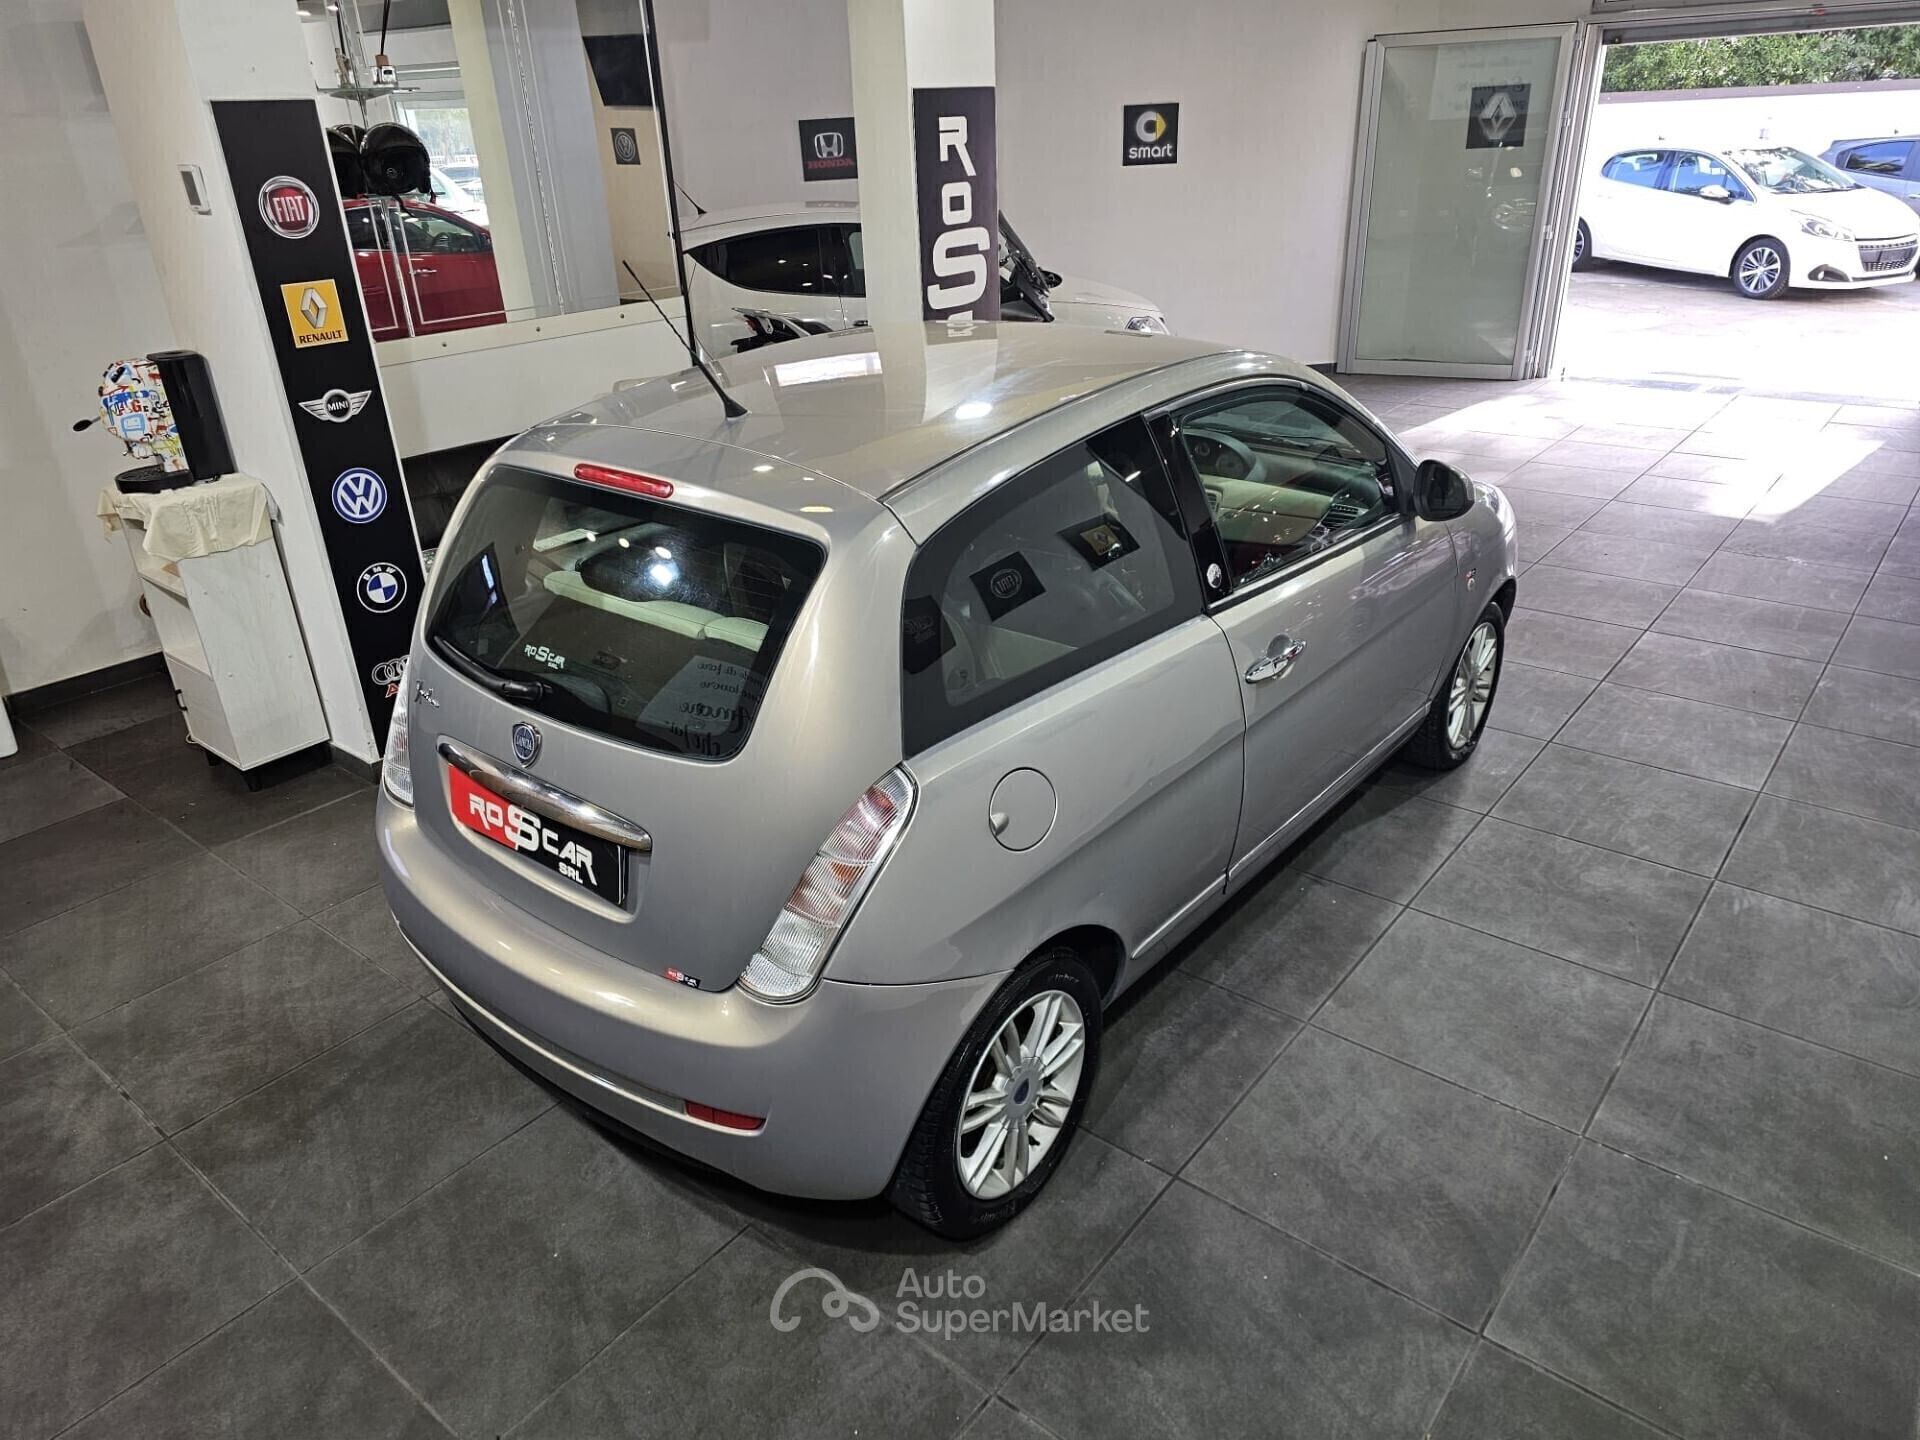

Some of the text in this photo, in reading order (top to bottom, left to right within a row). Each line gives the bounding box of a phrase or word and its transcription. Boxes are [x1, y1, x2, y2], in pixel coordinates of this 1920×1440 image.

[1129, 144, 1173, 159] smart
[807, 158, 855, 169] HONDA
[272, 195, 306, 223] FIAT
[299, 329, 343, 345] RENAULT
[327, 399, 350, 412] MINI
[363, 565, 397, 582] BMW
[558, 861, 584, 884] SRL
